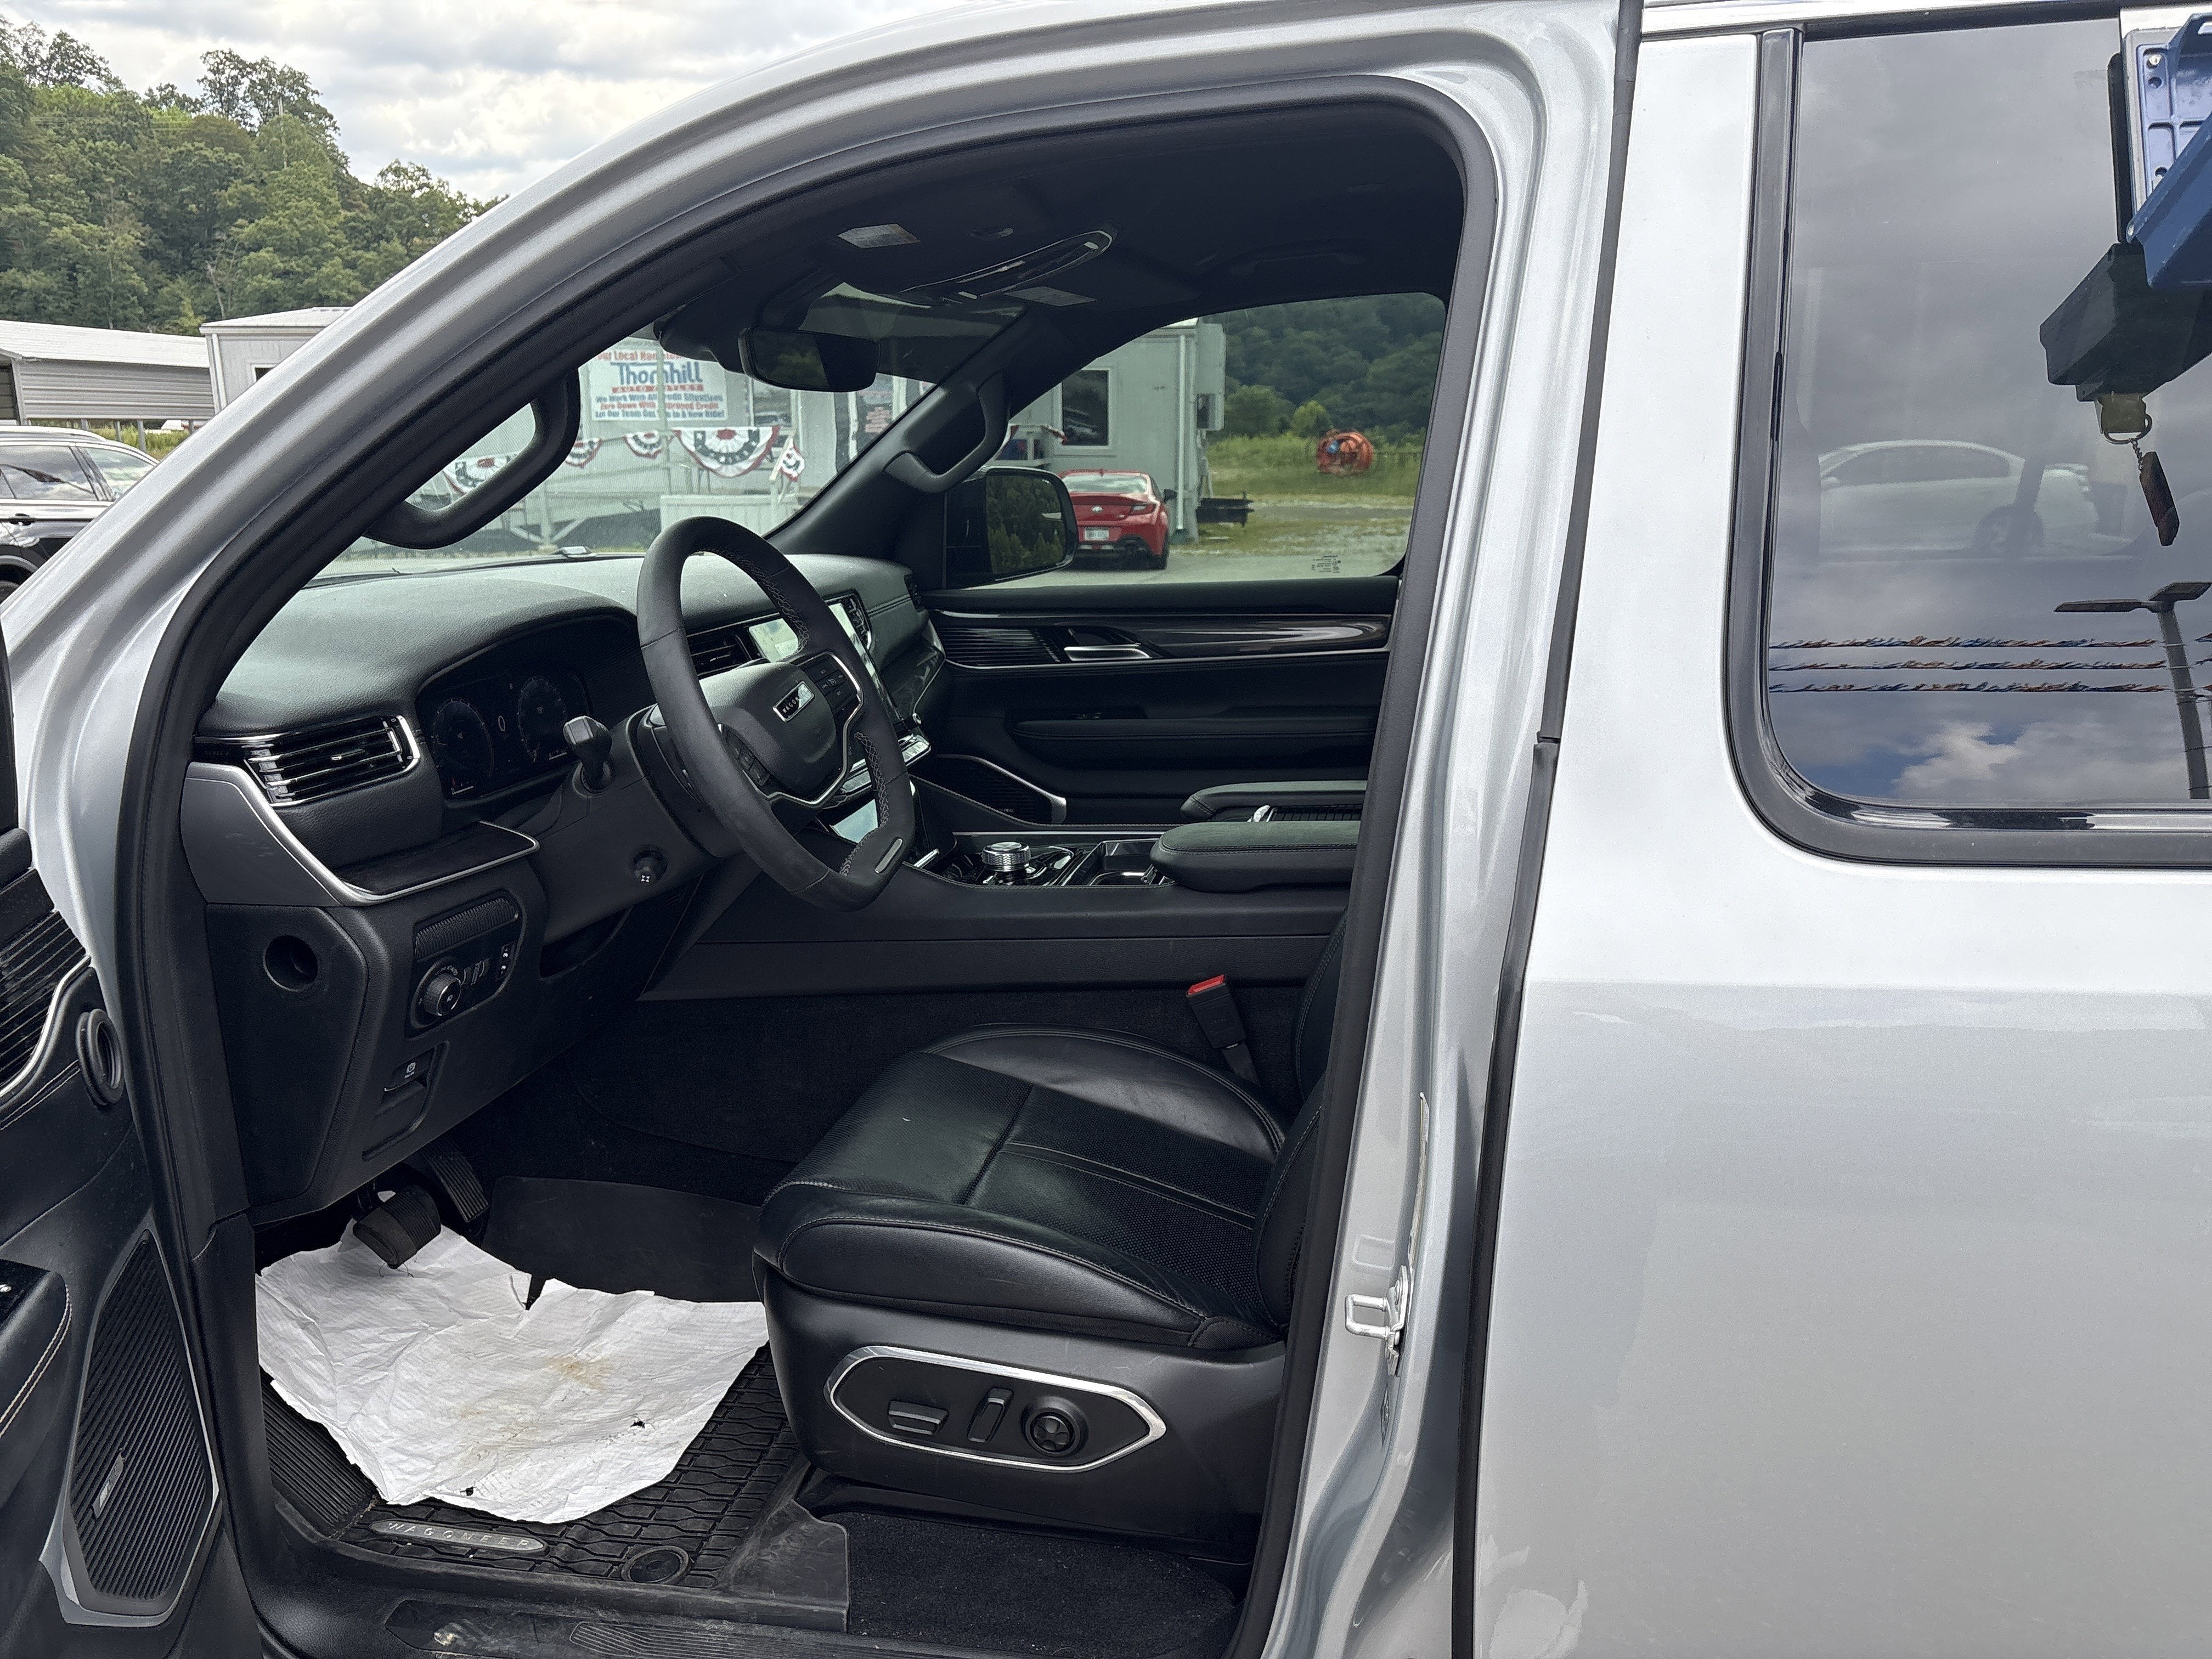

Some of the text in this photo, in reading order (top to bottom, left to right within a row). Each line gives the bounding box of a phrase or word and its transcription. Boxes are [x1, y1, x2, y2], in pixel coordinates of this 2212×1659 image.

[614, 351, 637, 360] Local
[610, 362, 703, 384] Thornhill
[664, 393, 682, 401] redit
[684, 393, 724, 402] Situations
[664, 401, 693, 409] pproved
[696, 401, 718, 410] Credit
[388, 1522, 530, 1547] WAGONEER
